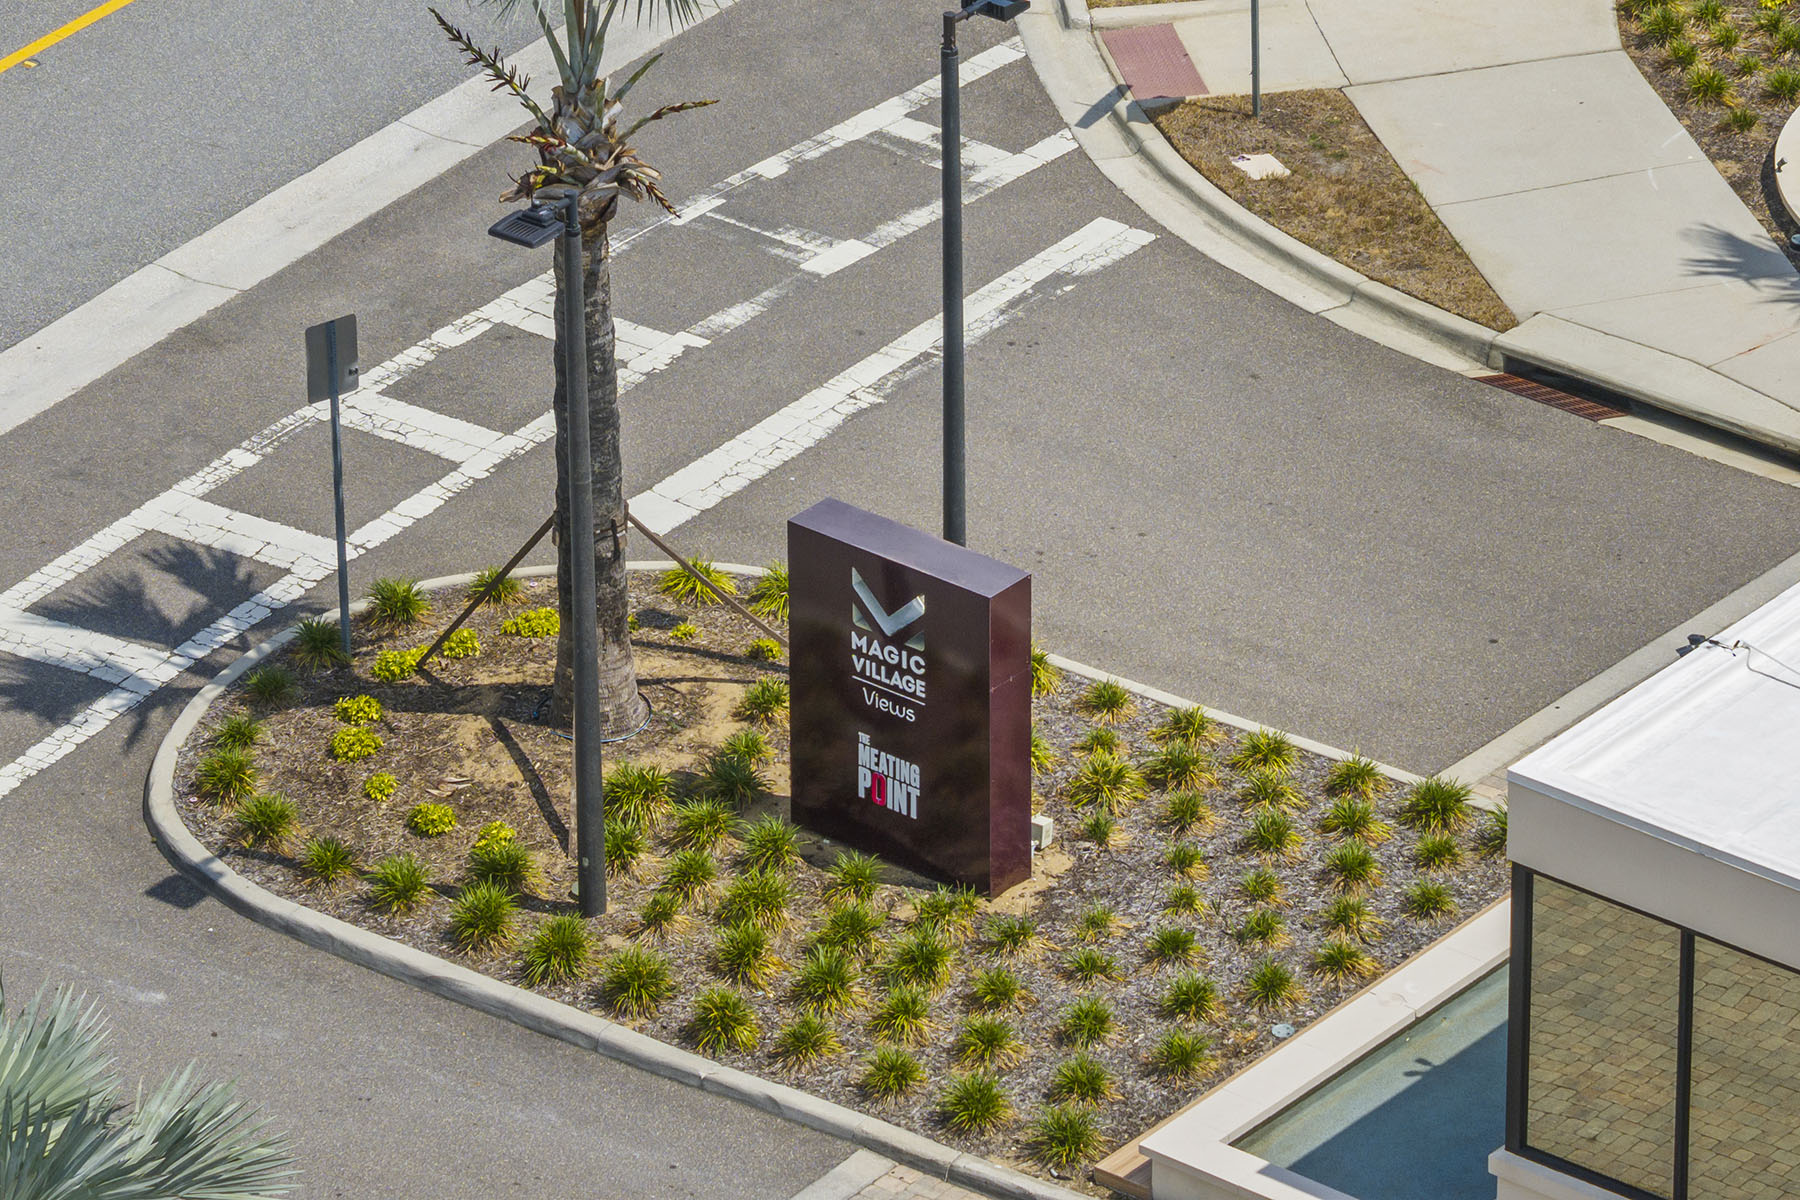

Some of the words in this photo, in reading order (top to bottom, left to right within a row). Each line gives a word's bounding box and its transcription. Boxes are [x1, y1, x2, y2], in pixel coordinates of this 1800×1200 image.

[851, 631, 926, 675] MAGIC
[851, 654, 926, 698] VILLAGE
[862, 687, 916, 722] Views
[858, 742, 920, 789] MEATING
[858, 765, 920, 820] POINT
